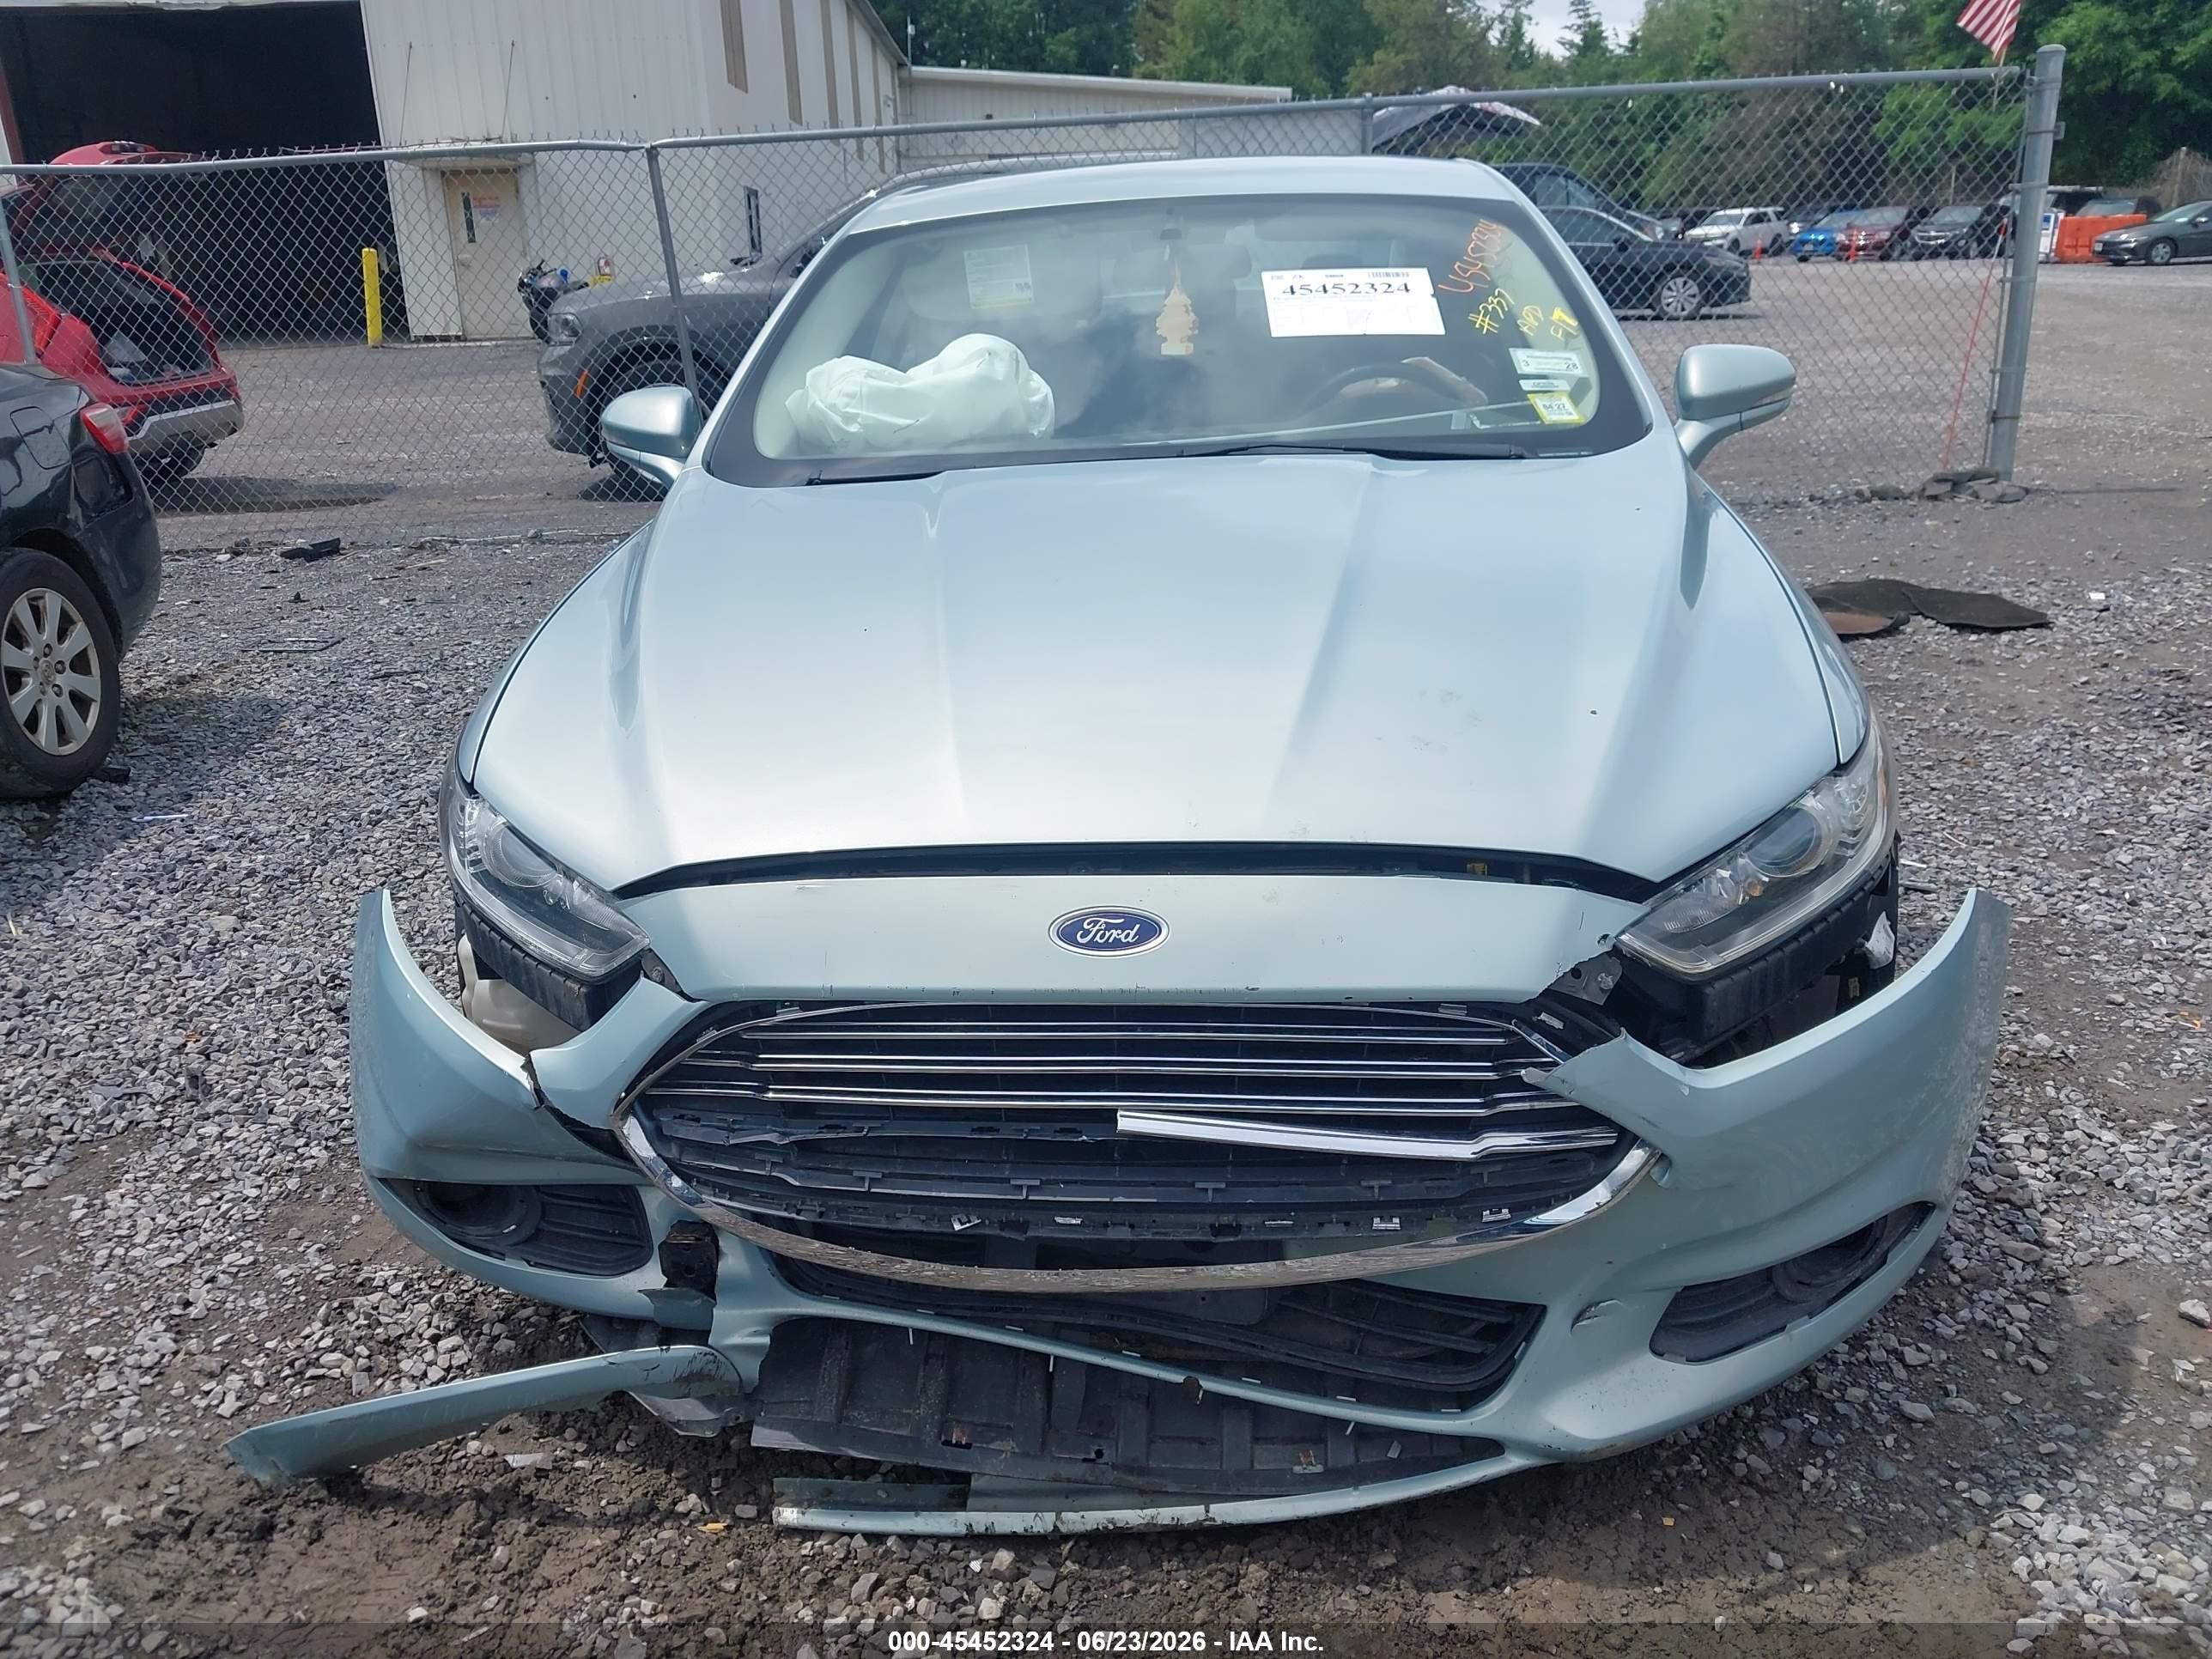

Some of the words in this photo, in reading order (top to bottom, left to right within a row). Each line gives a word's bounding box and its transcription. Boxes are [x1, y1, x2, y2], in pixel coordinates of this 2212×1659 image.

[1282, 282, 1411, 295] 45452324
[1468, 289, 1515, 334] #337
[1076, 917, 1140, 944] Ford
